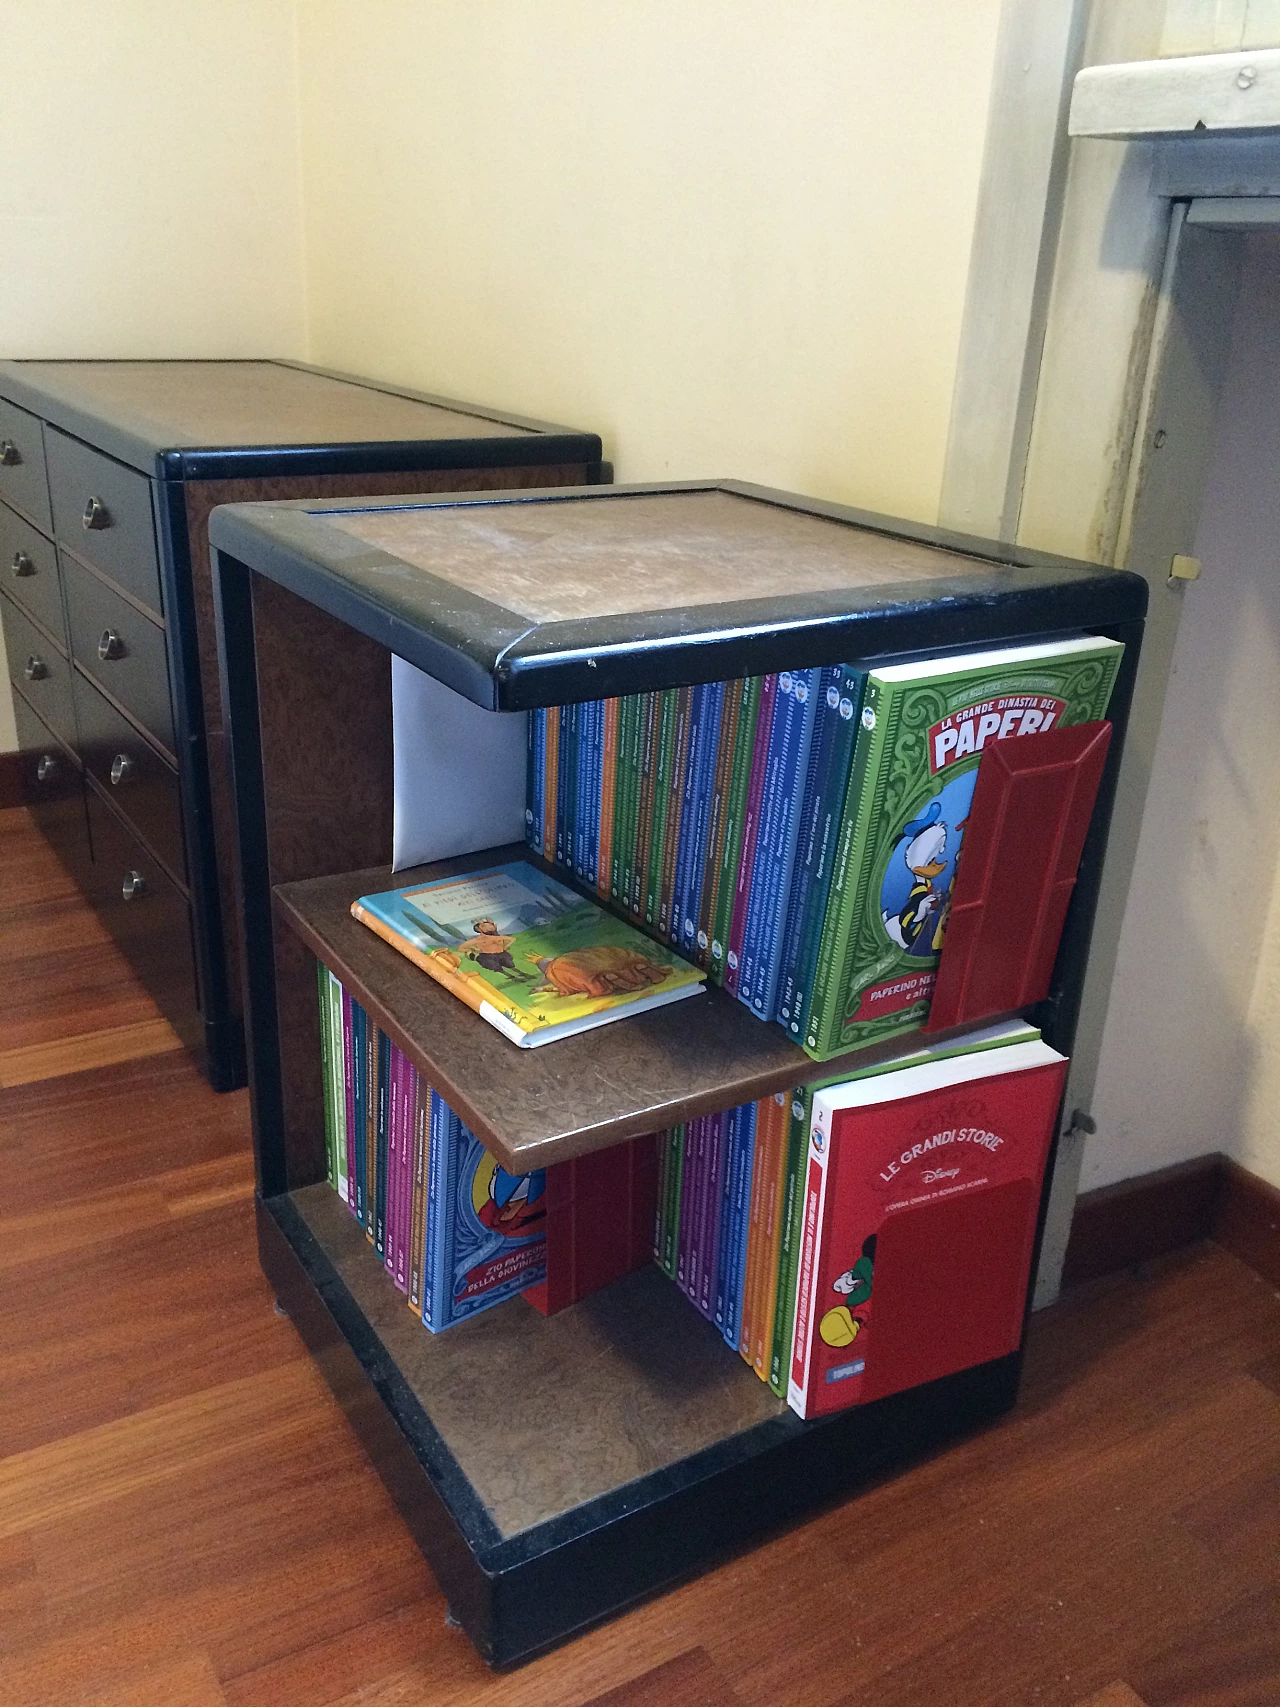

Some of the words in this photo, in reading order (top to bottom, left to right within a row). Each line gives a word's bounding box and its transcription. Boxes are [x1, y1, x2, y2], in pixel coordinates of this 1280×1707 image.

[833, 668, 841, 679] 33
[845, 678, 855, 690] 43
[870, 689, 876, 698] 3
[941, 718, 953, 730] LA
[956, 701, 995, 723] GRANDE
[998, 697, 1037, 710] DINASTIA
[1040, 698, 1056, 710] DEI
[934, 709, 1056, 769] PAPERI
[870, 979, 917, 1001] PAPERINO
[810, 1015, 819, 1032] 1951
[879, 1161, 901, 1182] LE
[900, 1129, 956, 1164] GRANDI
[957, 1128, 1004, 1152] STORIE
[921, 1168, 961, 1184] Disney
[485, 1263, 502, 1276] ZIO
[505, 1244, 546, 1267] PAPERON
[467, 1275, 496, 1293] DELLA
